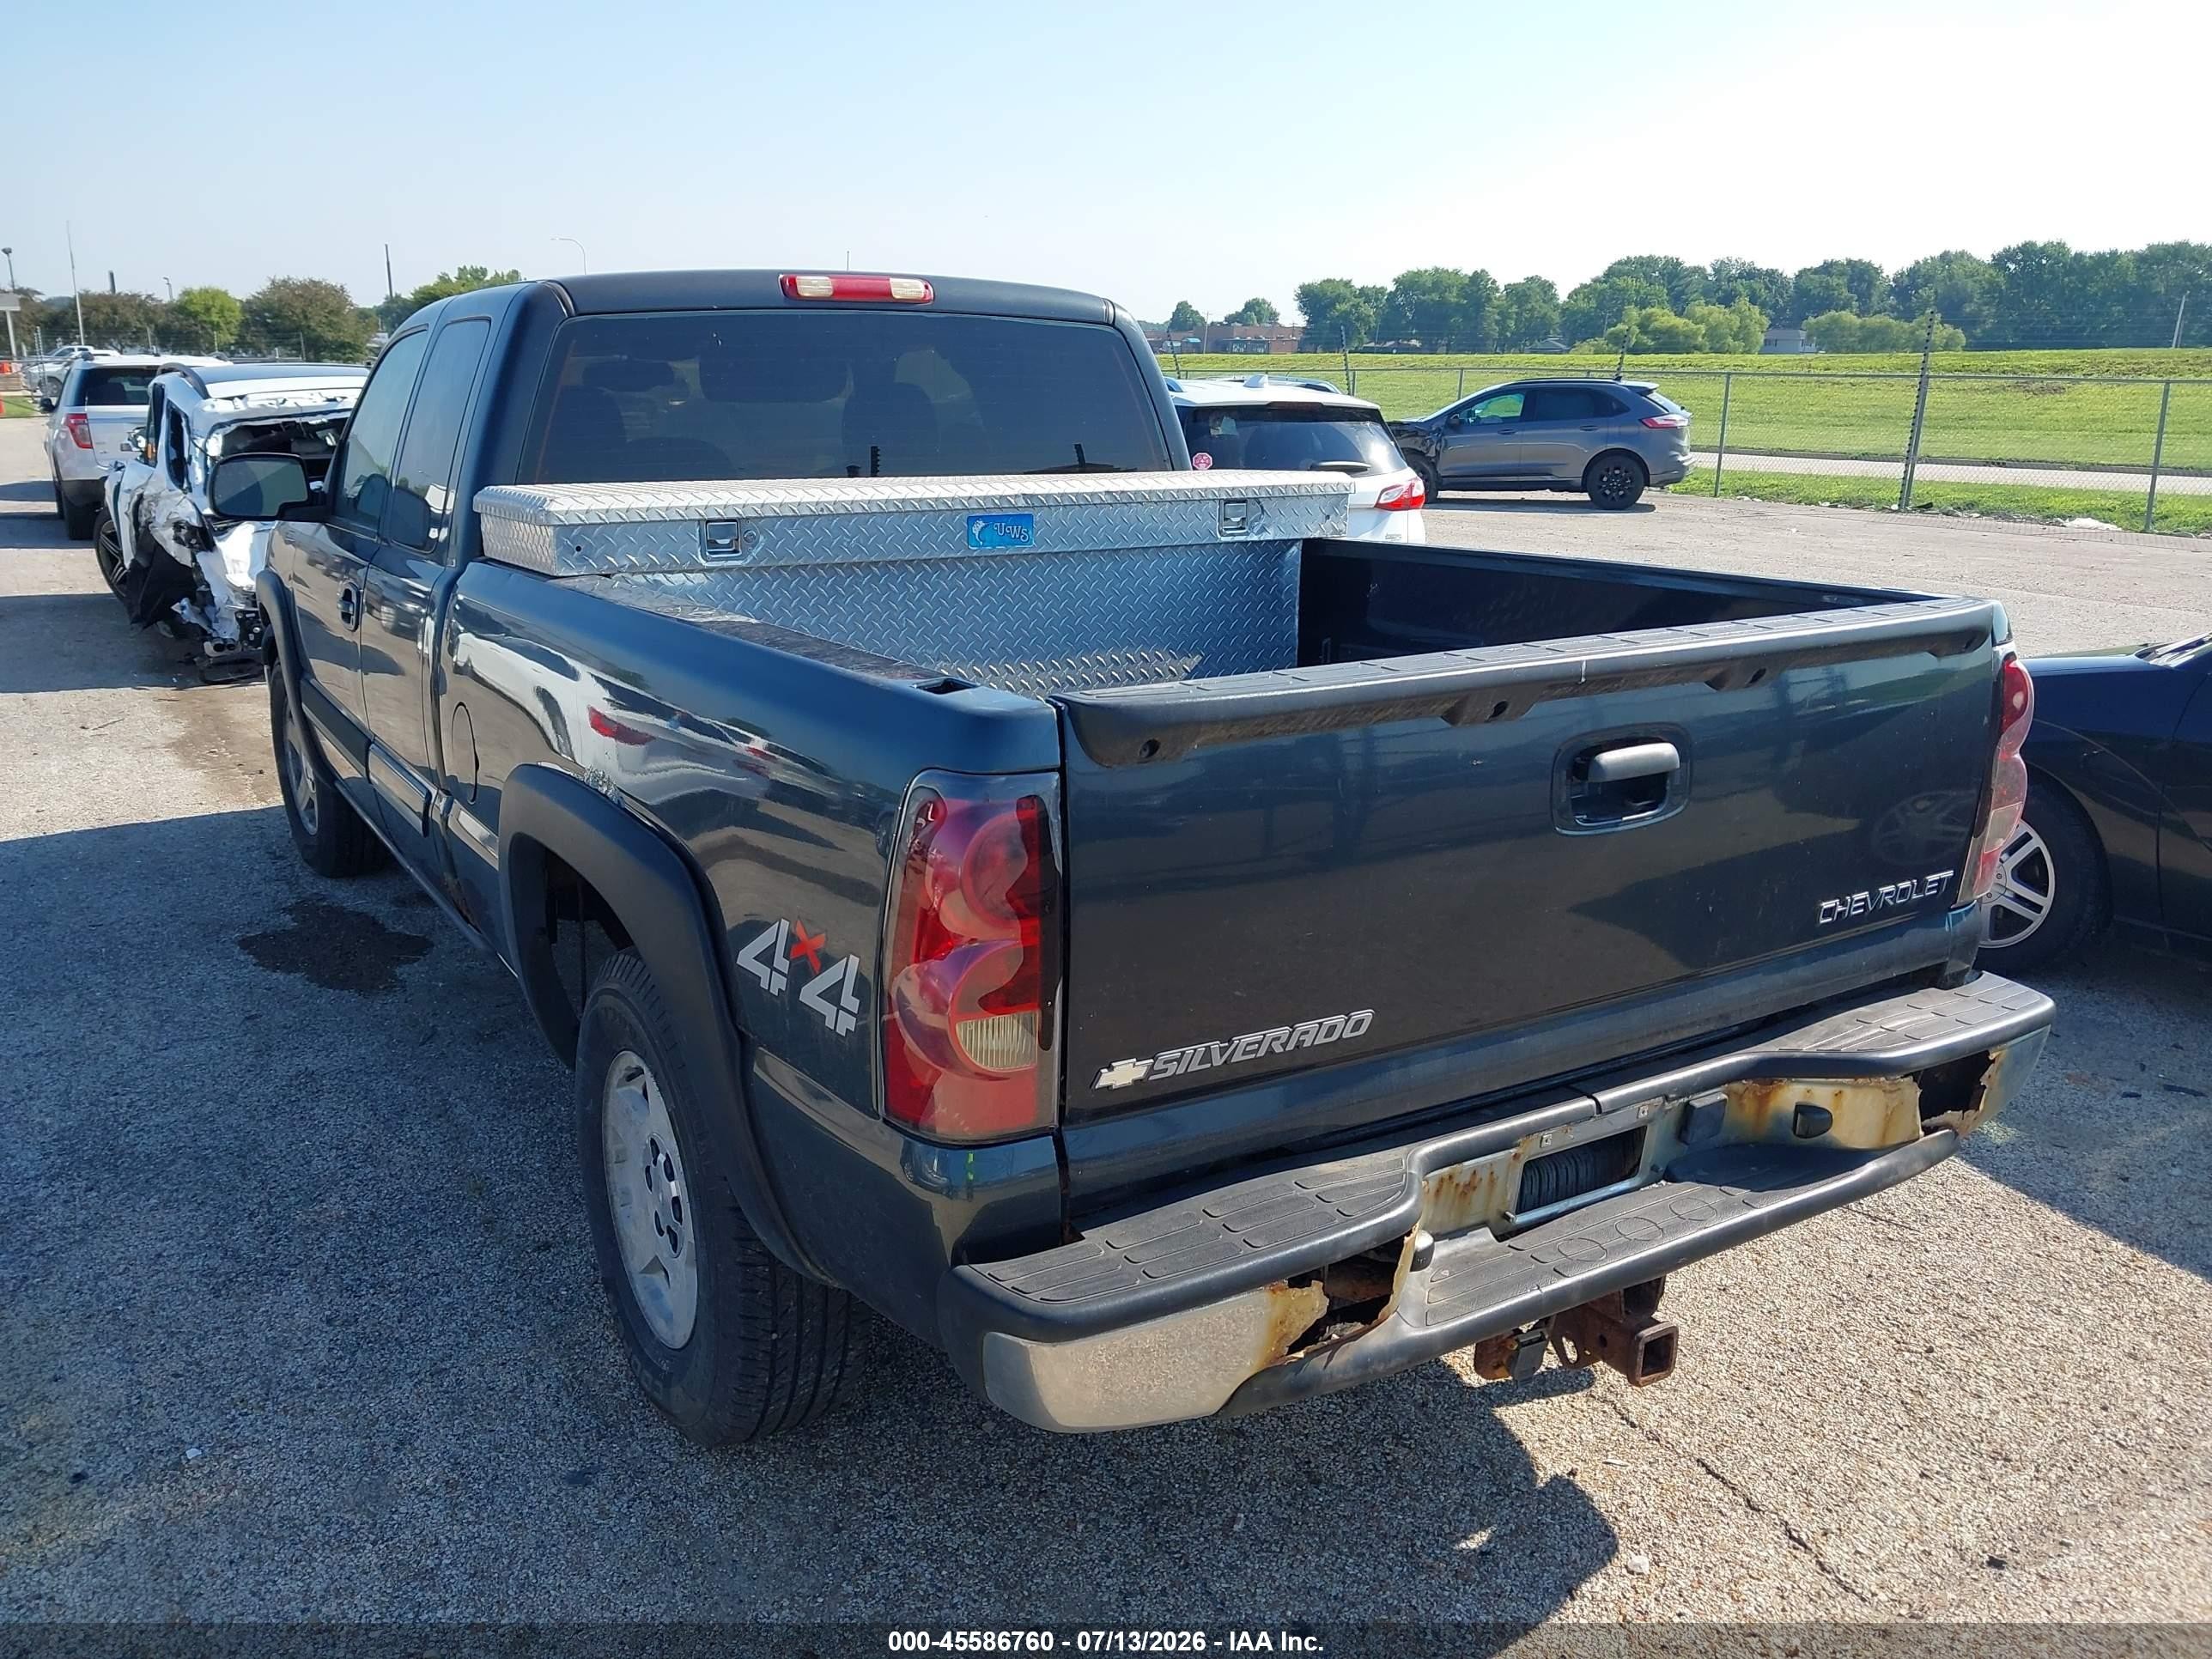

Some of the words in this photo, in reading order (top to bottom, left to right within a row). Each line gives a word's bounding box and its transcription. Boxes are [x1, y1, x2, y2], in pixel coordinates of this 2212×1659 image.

[993, 522, 1029, 543] UWS
[1817, 870, 1954, 925] CHEVROLET
[1148, 1009, 1375, 1081] SILVERADO
